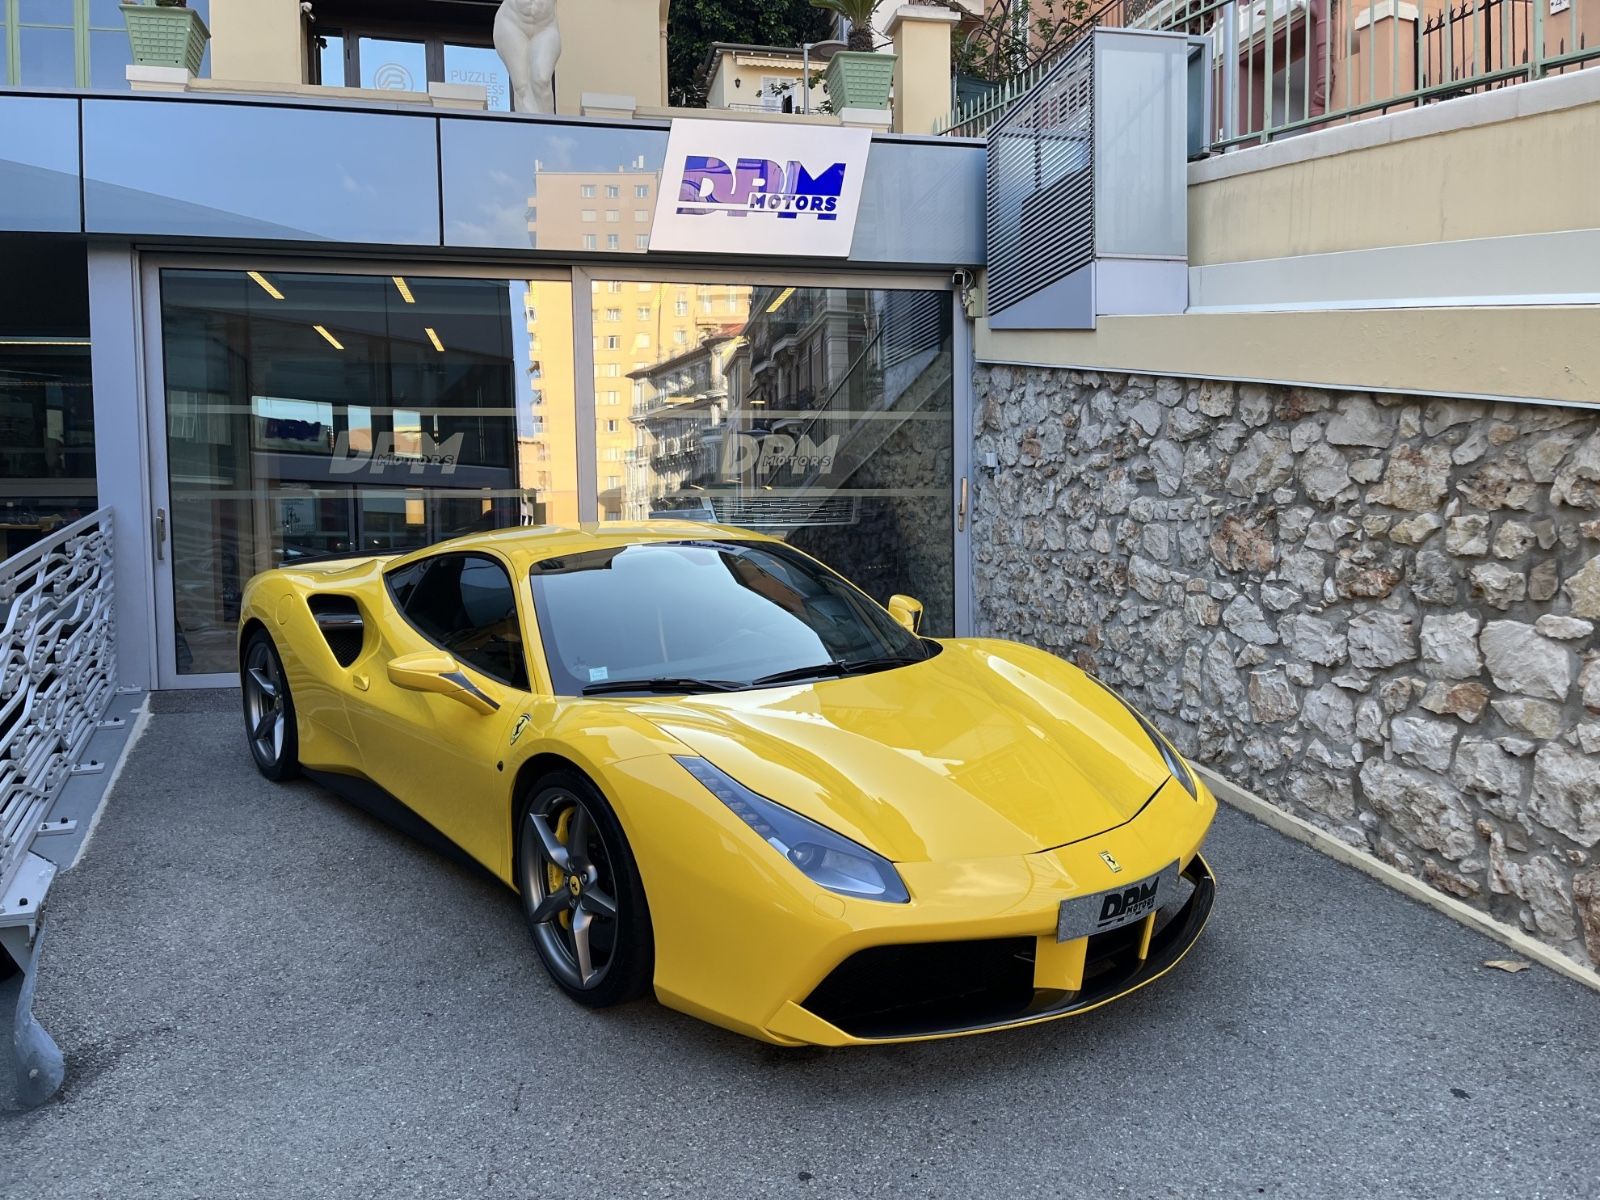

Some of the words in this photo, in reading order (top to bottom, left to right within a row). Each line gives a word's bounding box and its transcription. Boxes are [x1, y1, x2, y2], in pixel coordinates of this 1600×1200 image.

[450, 70, 497, 83] PUZZLE
[676, 155, 846, 220] DPM
[749, 192, 837, 212] MOTORS
[329, 431, 464, 474] DPM
[377, 454, 455, 467] MOTORS
[721, 434, 840, 474] DPM
[762, 455, 832, 467] MOTORS
[1098, 877, 1160, 927] DPM
